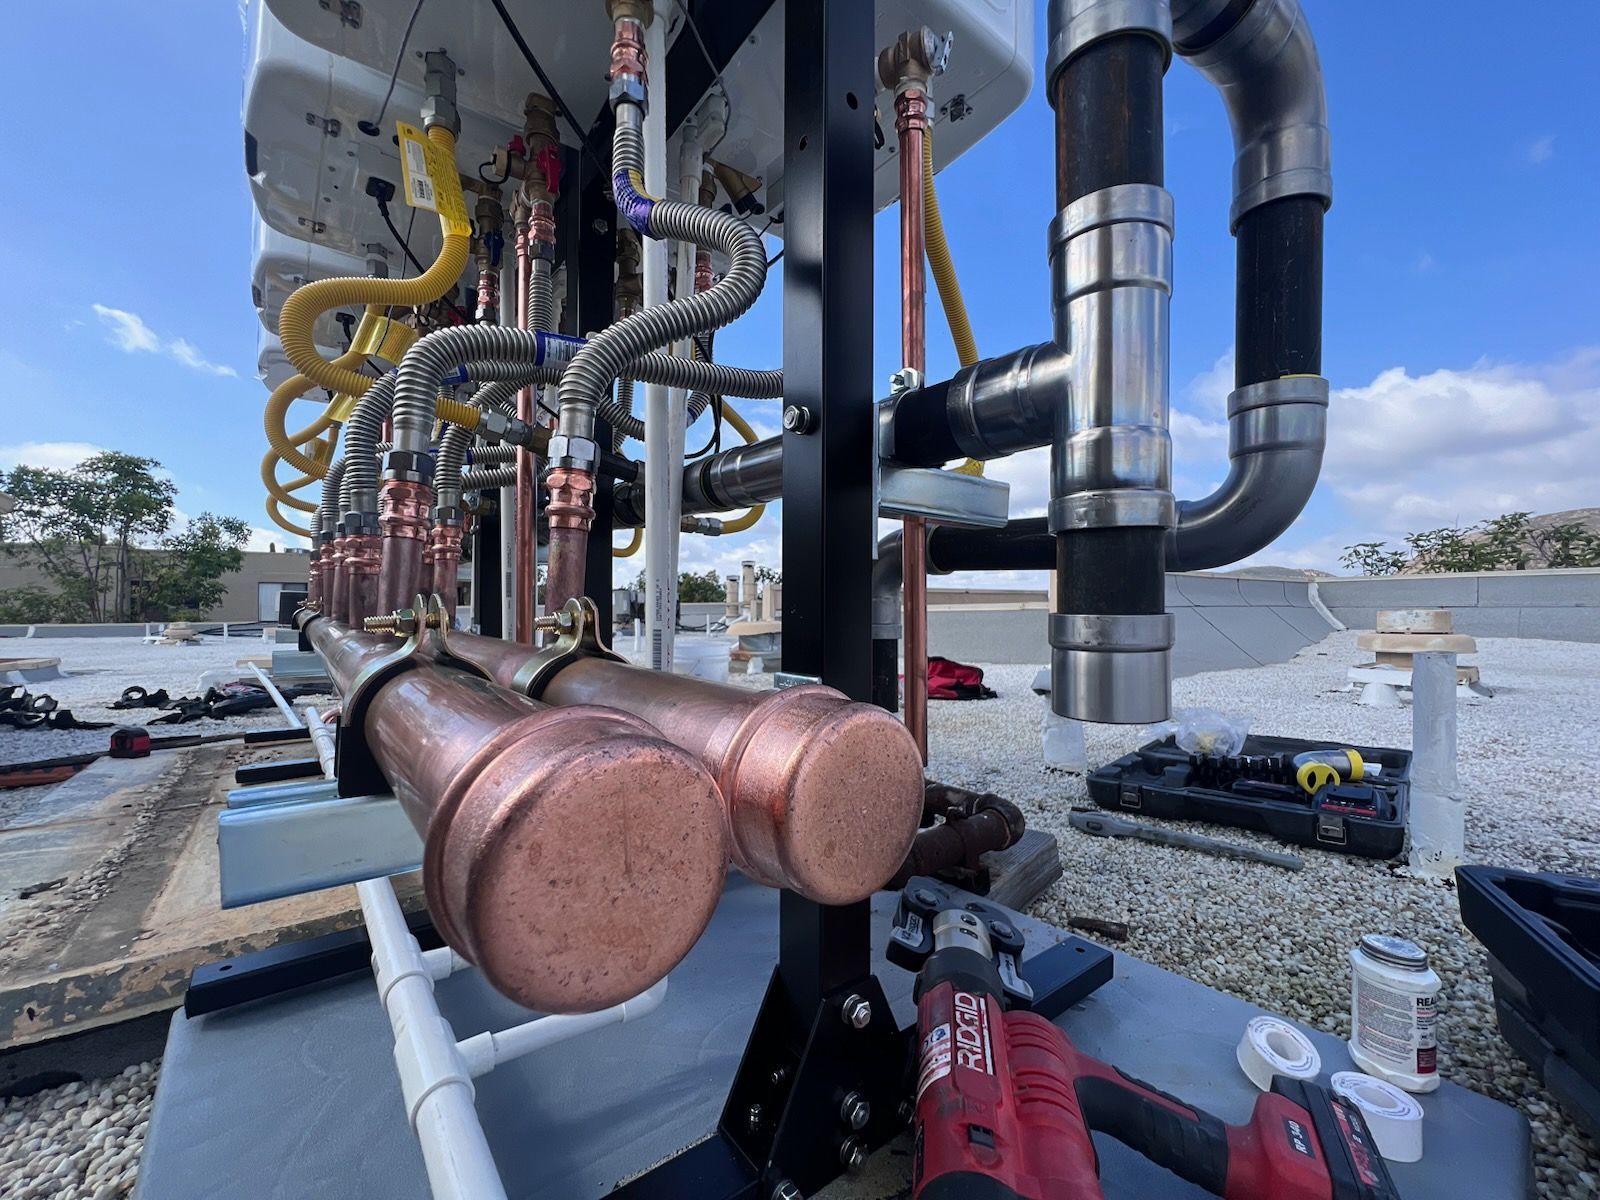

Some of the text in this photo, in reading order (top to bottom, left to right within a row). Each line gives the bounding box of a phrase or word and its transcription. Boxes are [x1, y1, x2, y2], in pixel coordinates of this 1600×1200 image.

[955, 992, 984, 1073] RIDGID
[1288, 1120, 1308, 1154] RP 340
